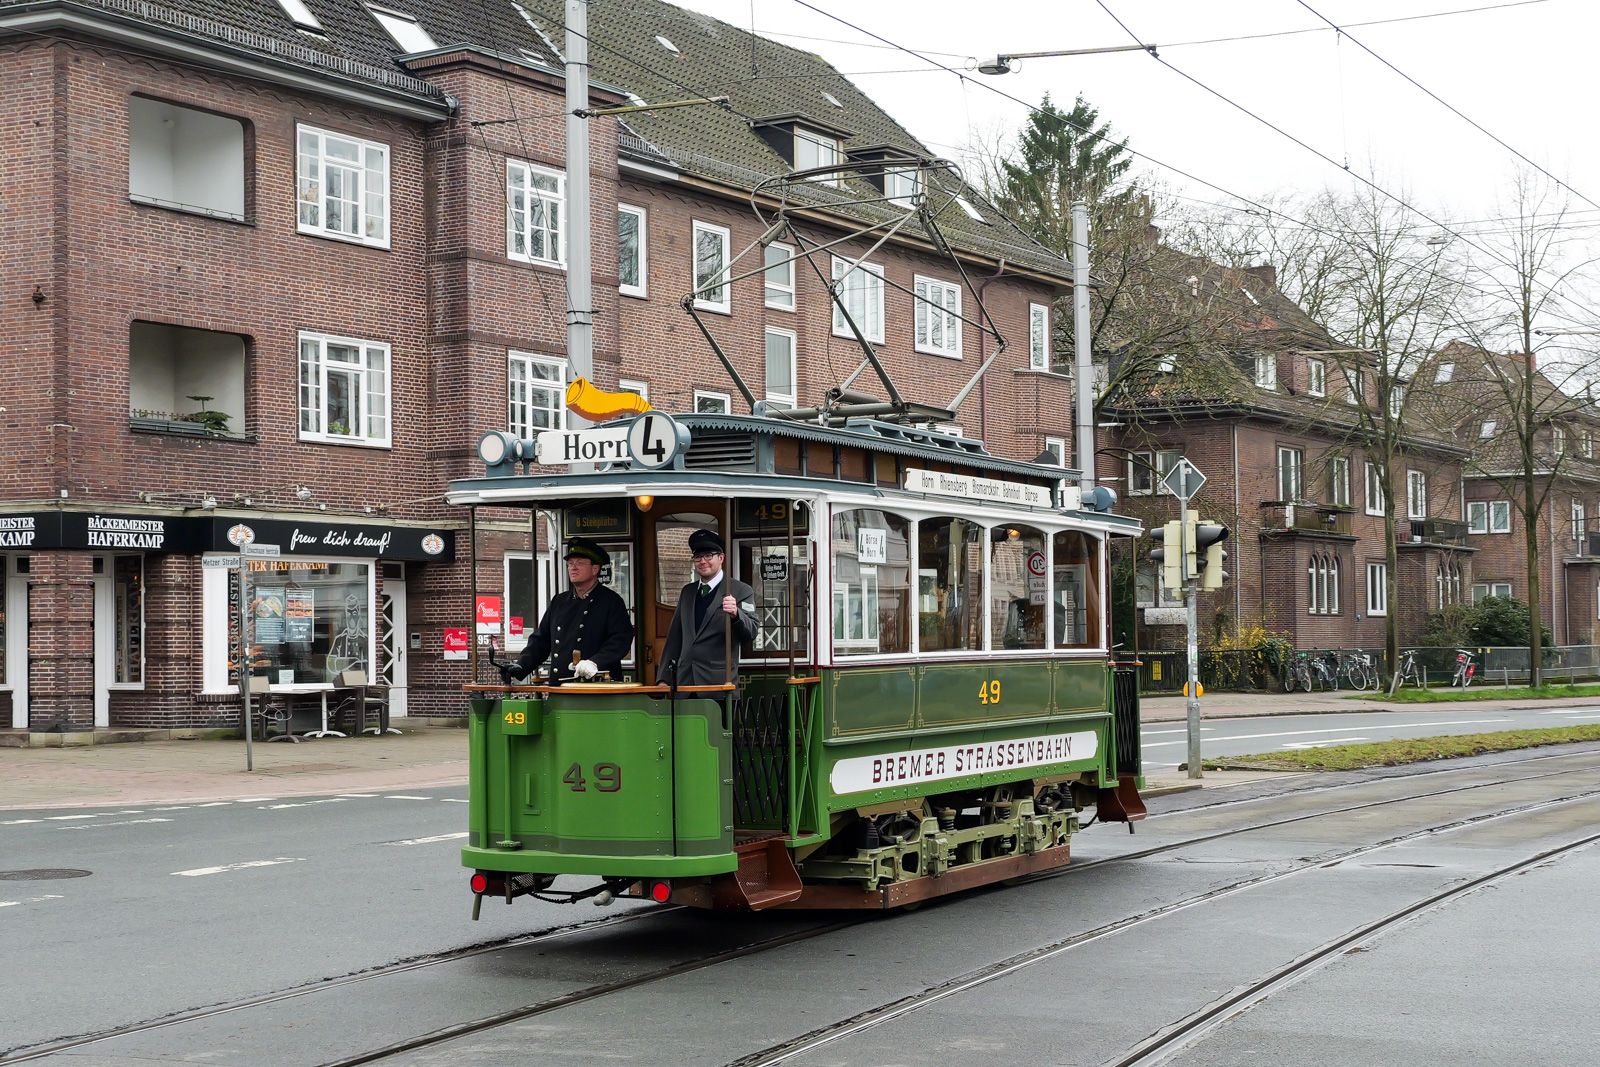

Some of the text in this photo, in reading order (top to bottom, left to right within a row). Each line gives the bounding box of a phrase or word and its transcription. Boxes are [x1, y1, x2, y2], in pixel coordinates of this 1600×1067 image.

[563, 434, 631, 460] Horn
[642, 416, 666, 462] 4
[922, 472, 934, 488] Horn
[1002, 483, 1020, 499] Bahnhof
[1024, 486, 1038, 502] Börse
[0, 517, 35, 528] EISTER
[88, 515, 164, 531] BÄCKERMEISTER
[754, 504, 786, 520] 49
[0, 531, 35, 546] KAMP
[88, 532, 164, 548] HAFERKAMP
[290, 528, 392, 554] freu dich drauf!
[860, 534, 864, 556] 4
[880, 535, 884, 558] 4
[478, 635, 489, 644] 95
[978, 680, 1001, 706] 49
[504, 712, 525, 725] 49
[873, 736, 1072, 784] BREMER STRASSENBAHN
[562, 762, 622, 793] 49
